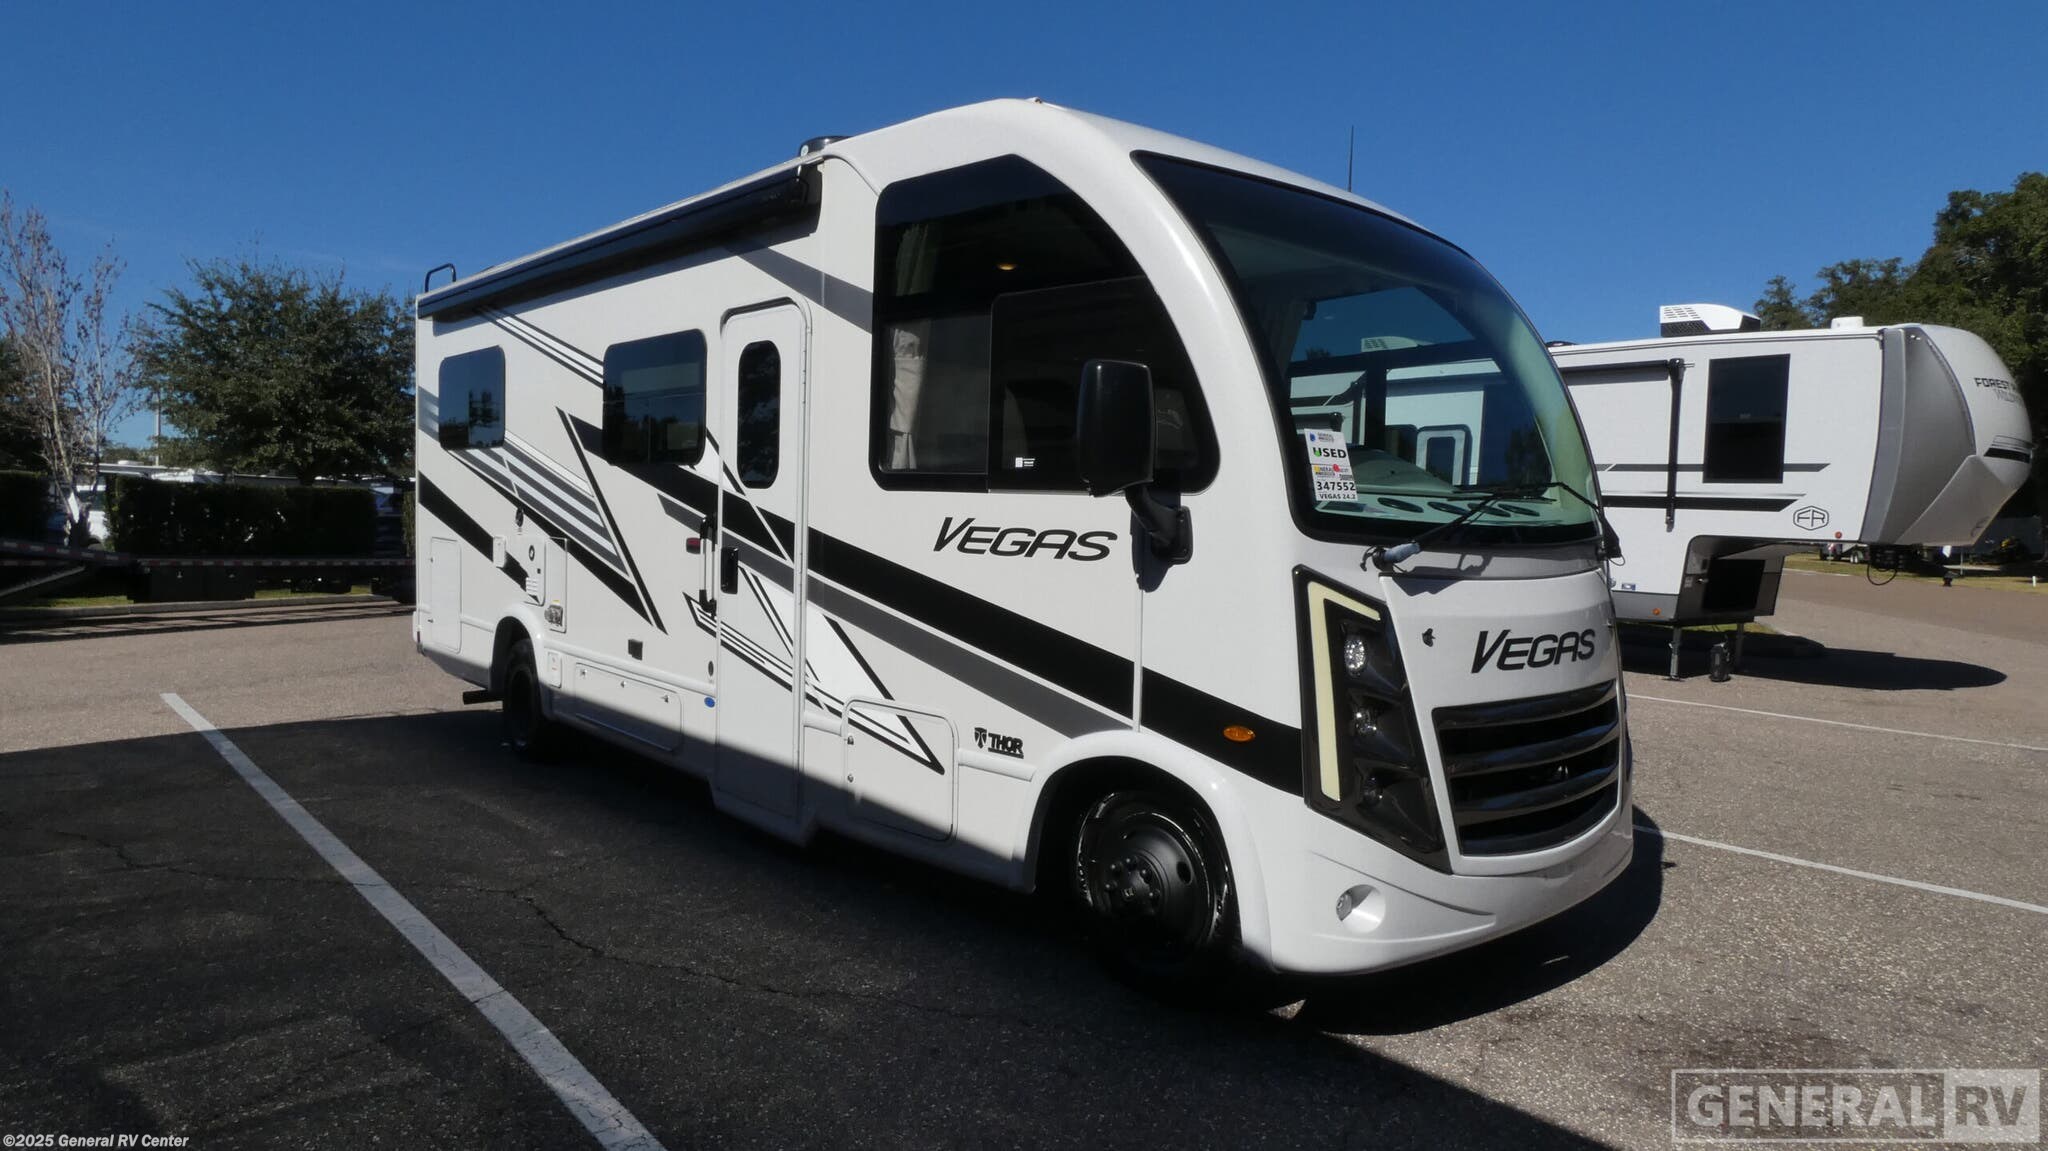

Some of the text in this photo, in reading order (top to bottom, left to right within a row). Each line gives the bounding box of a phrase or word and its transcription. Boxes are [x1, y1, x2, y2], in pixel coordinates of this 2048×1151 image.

[1312, 446, 1347, 459] USED
[1316, 481, 1356, 491] 347552
[933, 516, 1118, 562] VEGAS
[1471, 628, 1596, 674] VEGAS
[988, 732, 1024, 755] THOR
